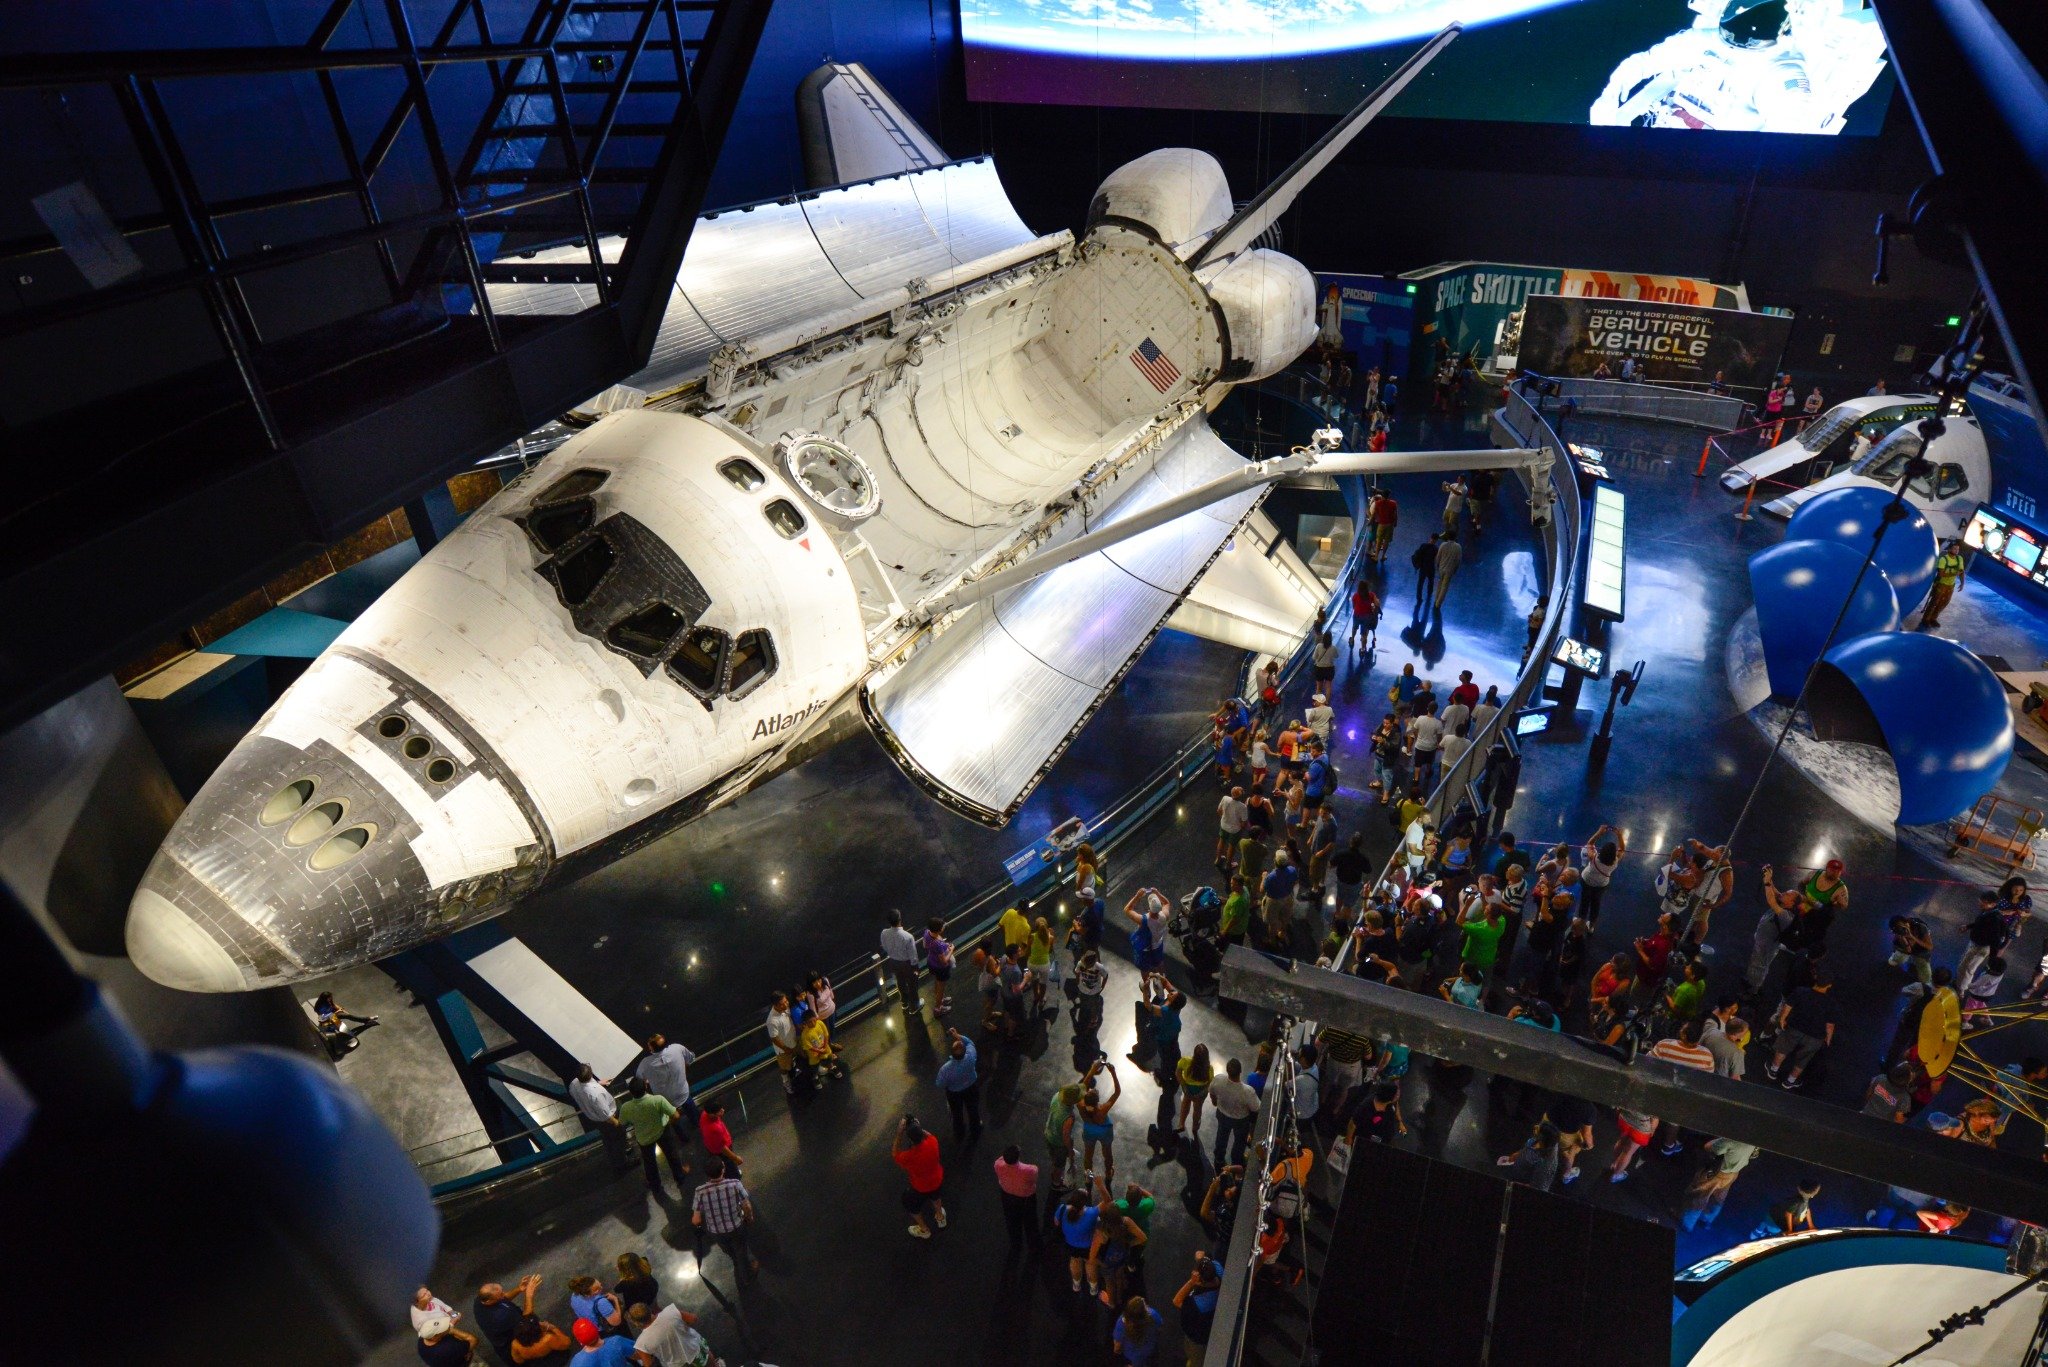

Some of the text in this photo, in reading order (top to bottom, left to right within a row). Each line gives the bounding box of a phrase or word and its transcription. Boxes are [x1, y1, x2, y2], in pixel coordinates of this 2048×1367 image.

[1435, 275, 1467, 312] SPACE
[1471, 273, 1557, 305] SHUTTLE
[1589, 315, 1712, 339] BEAUTIFUL
[1588, 330, 1709, 357] VEHICLE
[2006, 492, 2036, 518] SPEED
